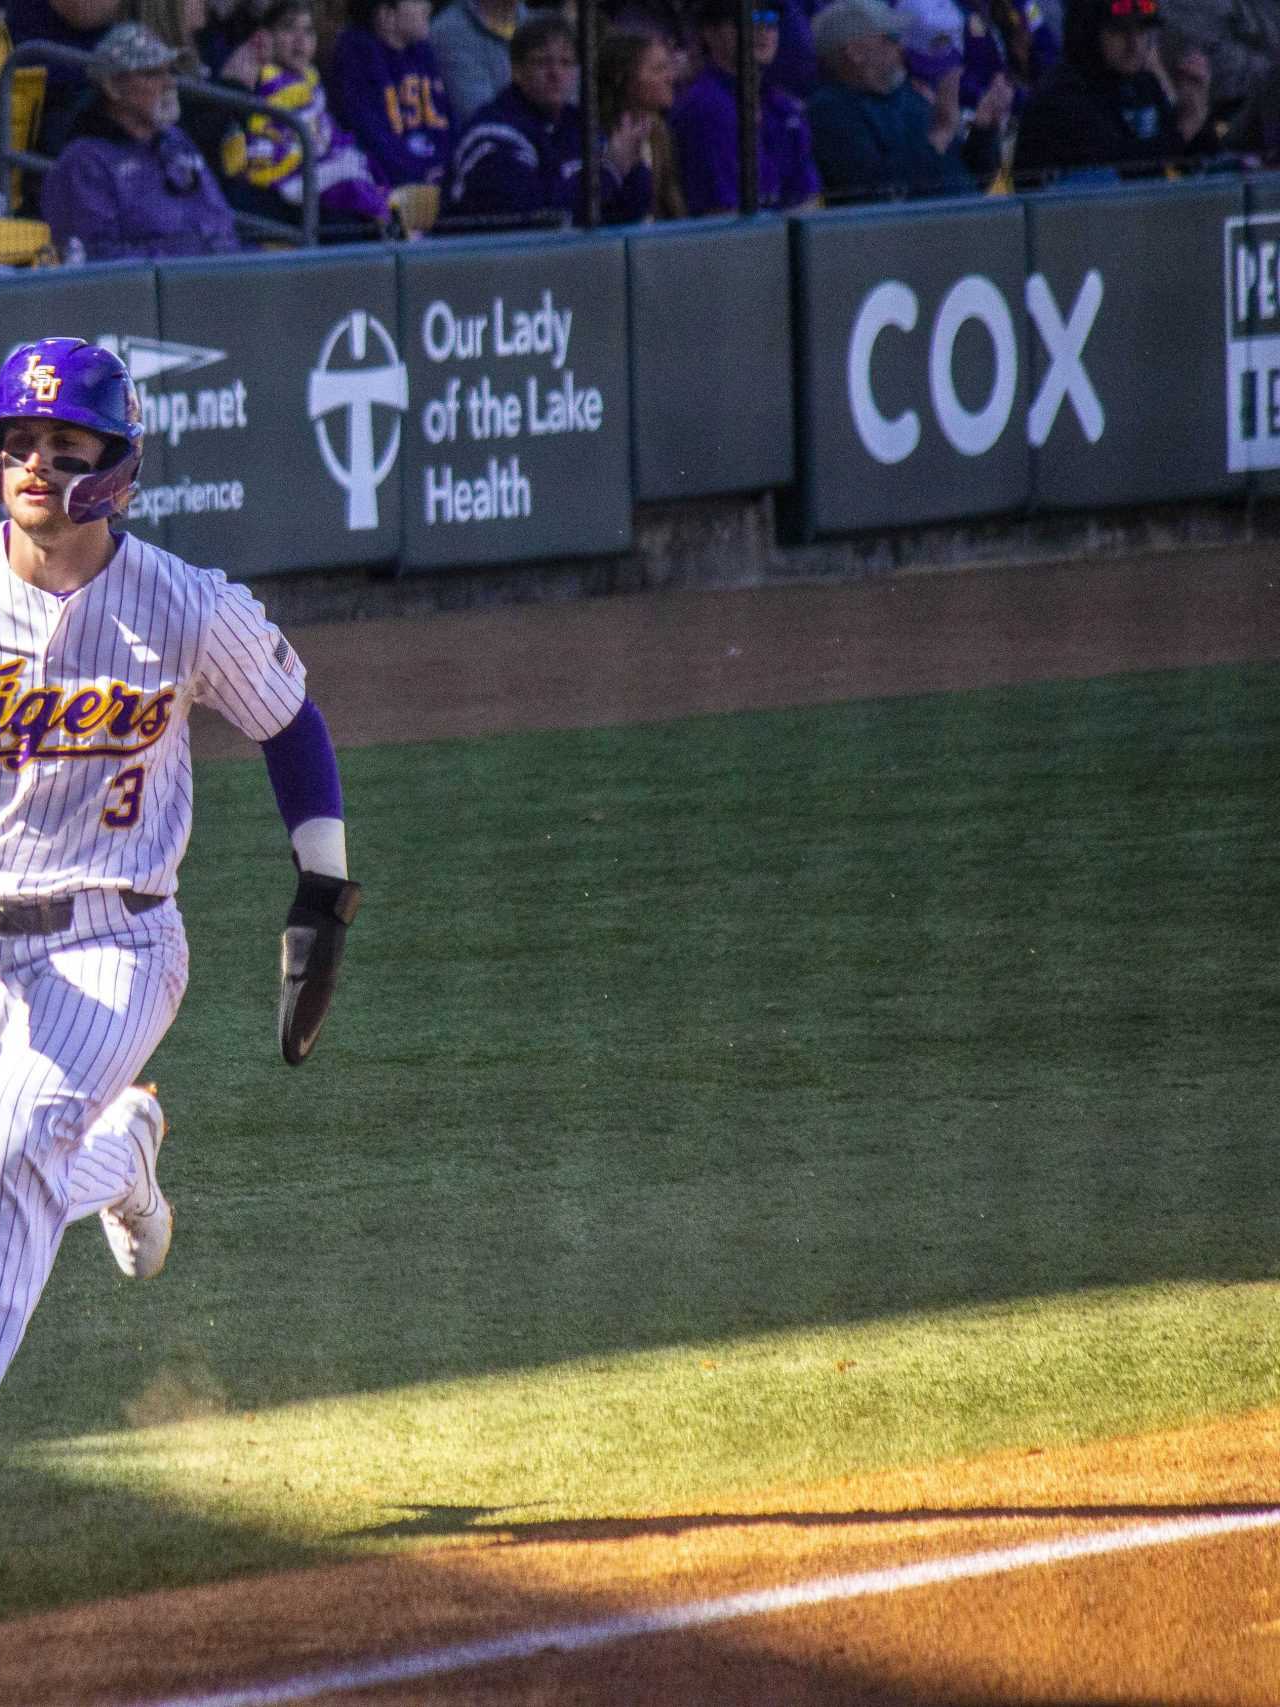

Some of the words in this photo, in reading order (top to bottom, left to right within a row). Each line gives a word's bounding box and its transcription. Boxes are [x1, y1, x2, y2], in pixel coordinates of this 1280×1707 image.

[1236, 241, 1280, 322] PE
[422, 299, 488, 362] Our
[494, 288, 573, 369] Lady
[847, 267, 1106, 465] COX
[423, 376, 461, 444] of
[470, 375, 521, 441] the
[527, 368, 604, 436] Lake
[423, 454, 532, 526] Health
[103, 763, 146, 830] 3
